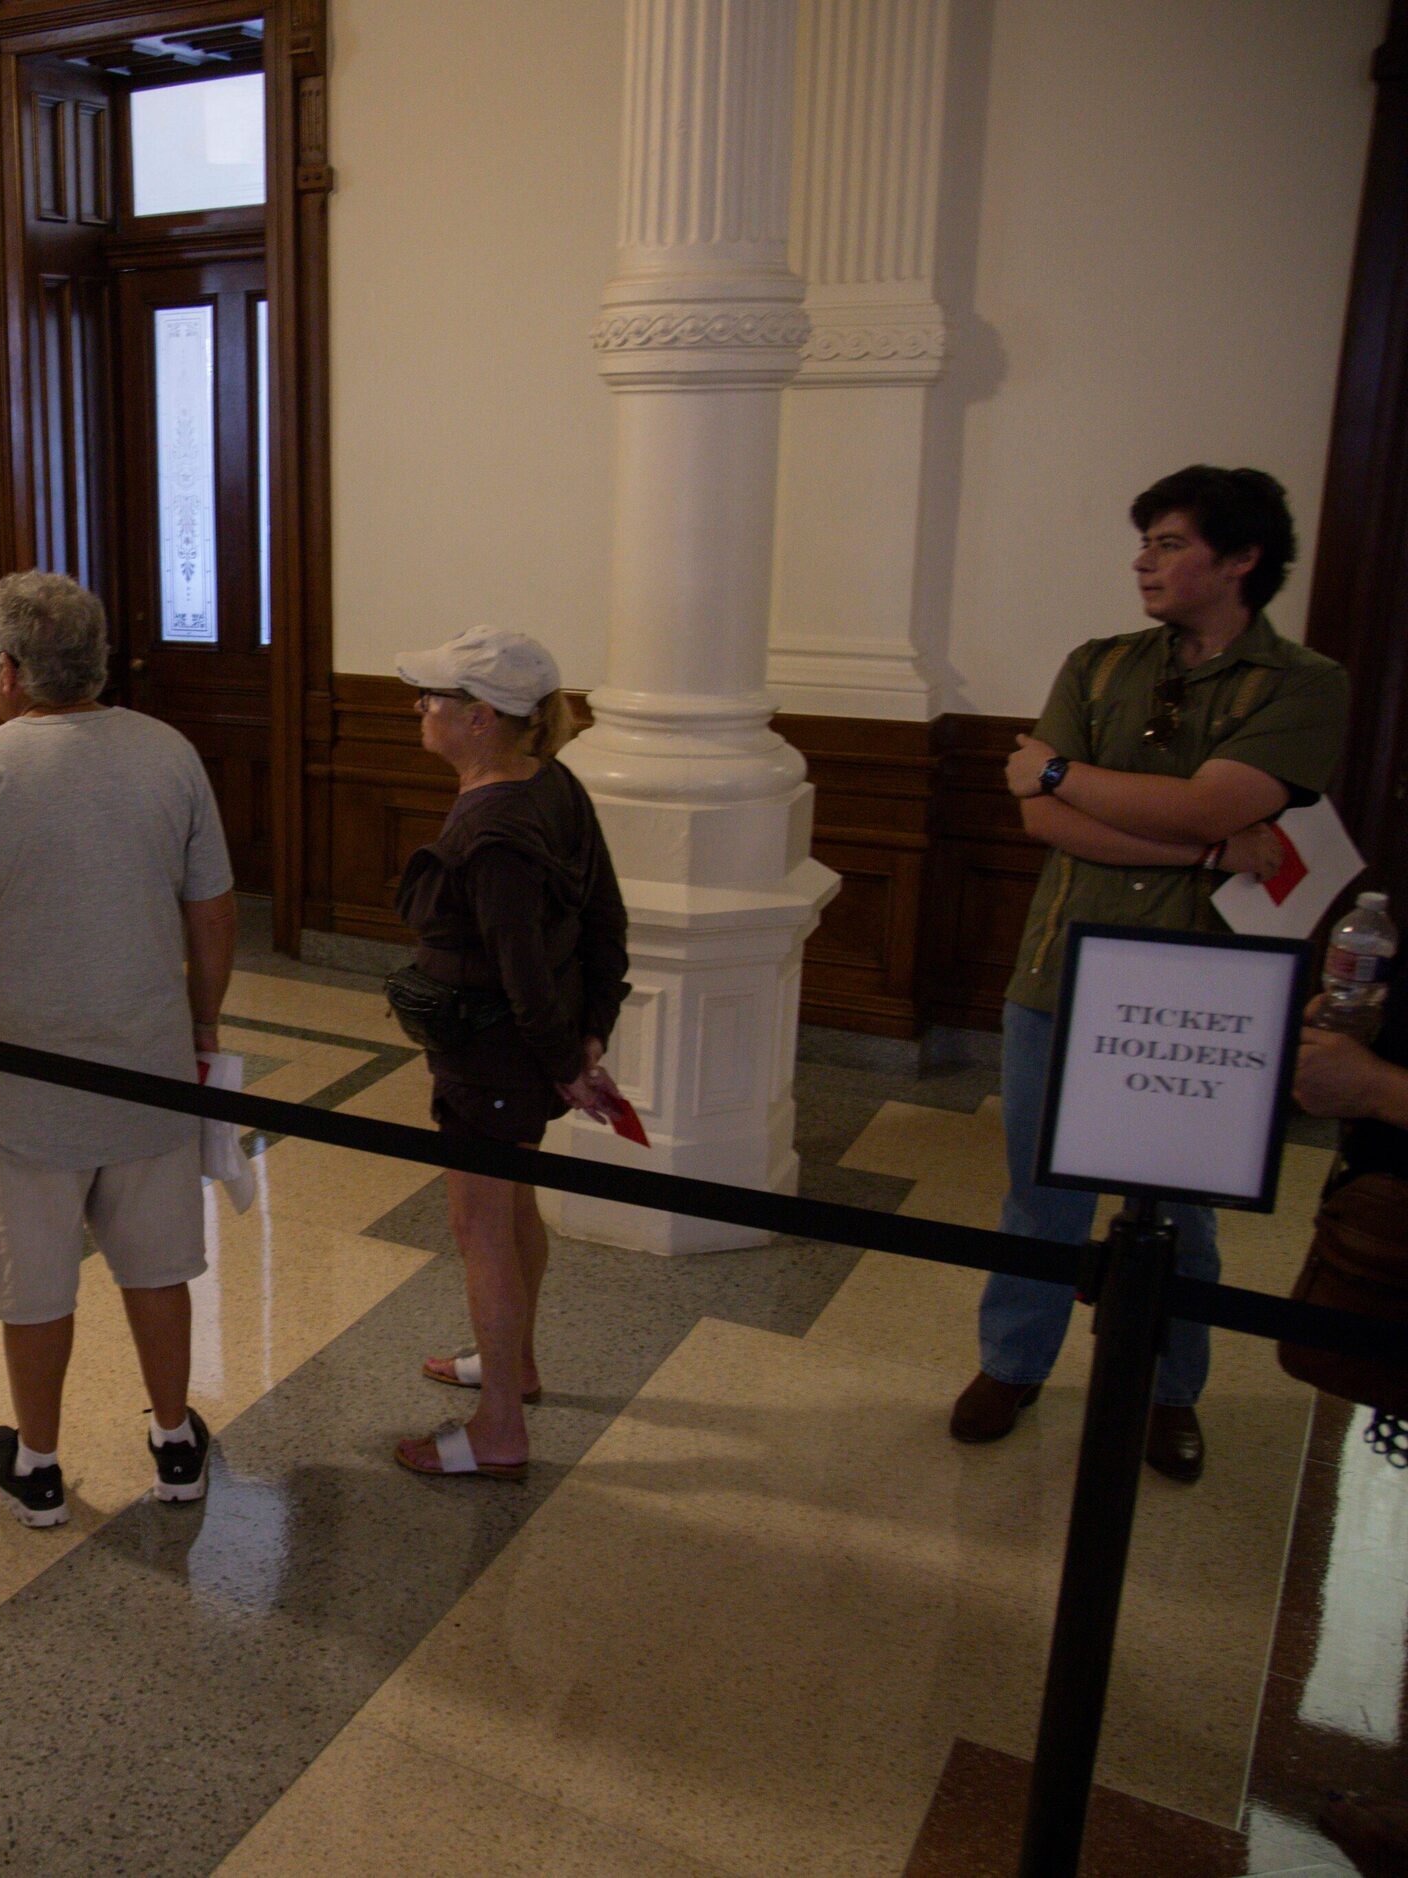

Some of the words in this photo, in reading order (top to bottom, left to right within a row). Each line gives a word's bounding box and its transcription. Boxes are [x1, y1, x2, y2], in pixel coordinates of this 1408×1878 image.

[1117, 1003, 1253, 1035] TICKET
[1094, 1036, 1267, 1070] HOLDERS
[1125, 1073, 1223, 1099] ONLY
